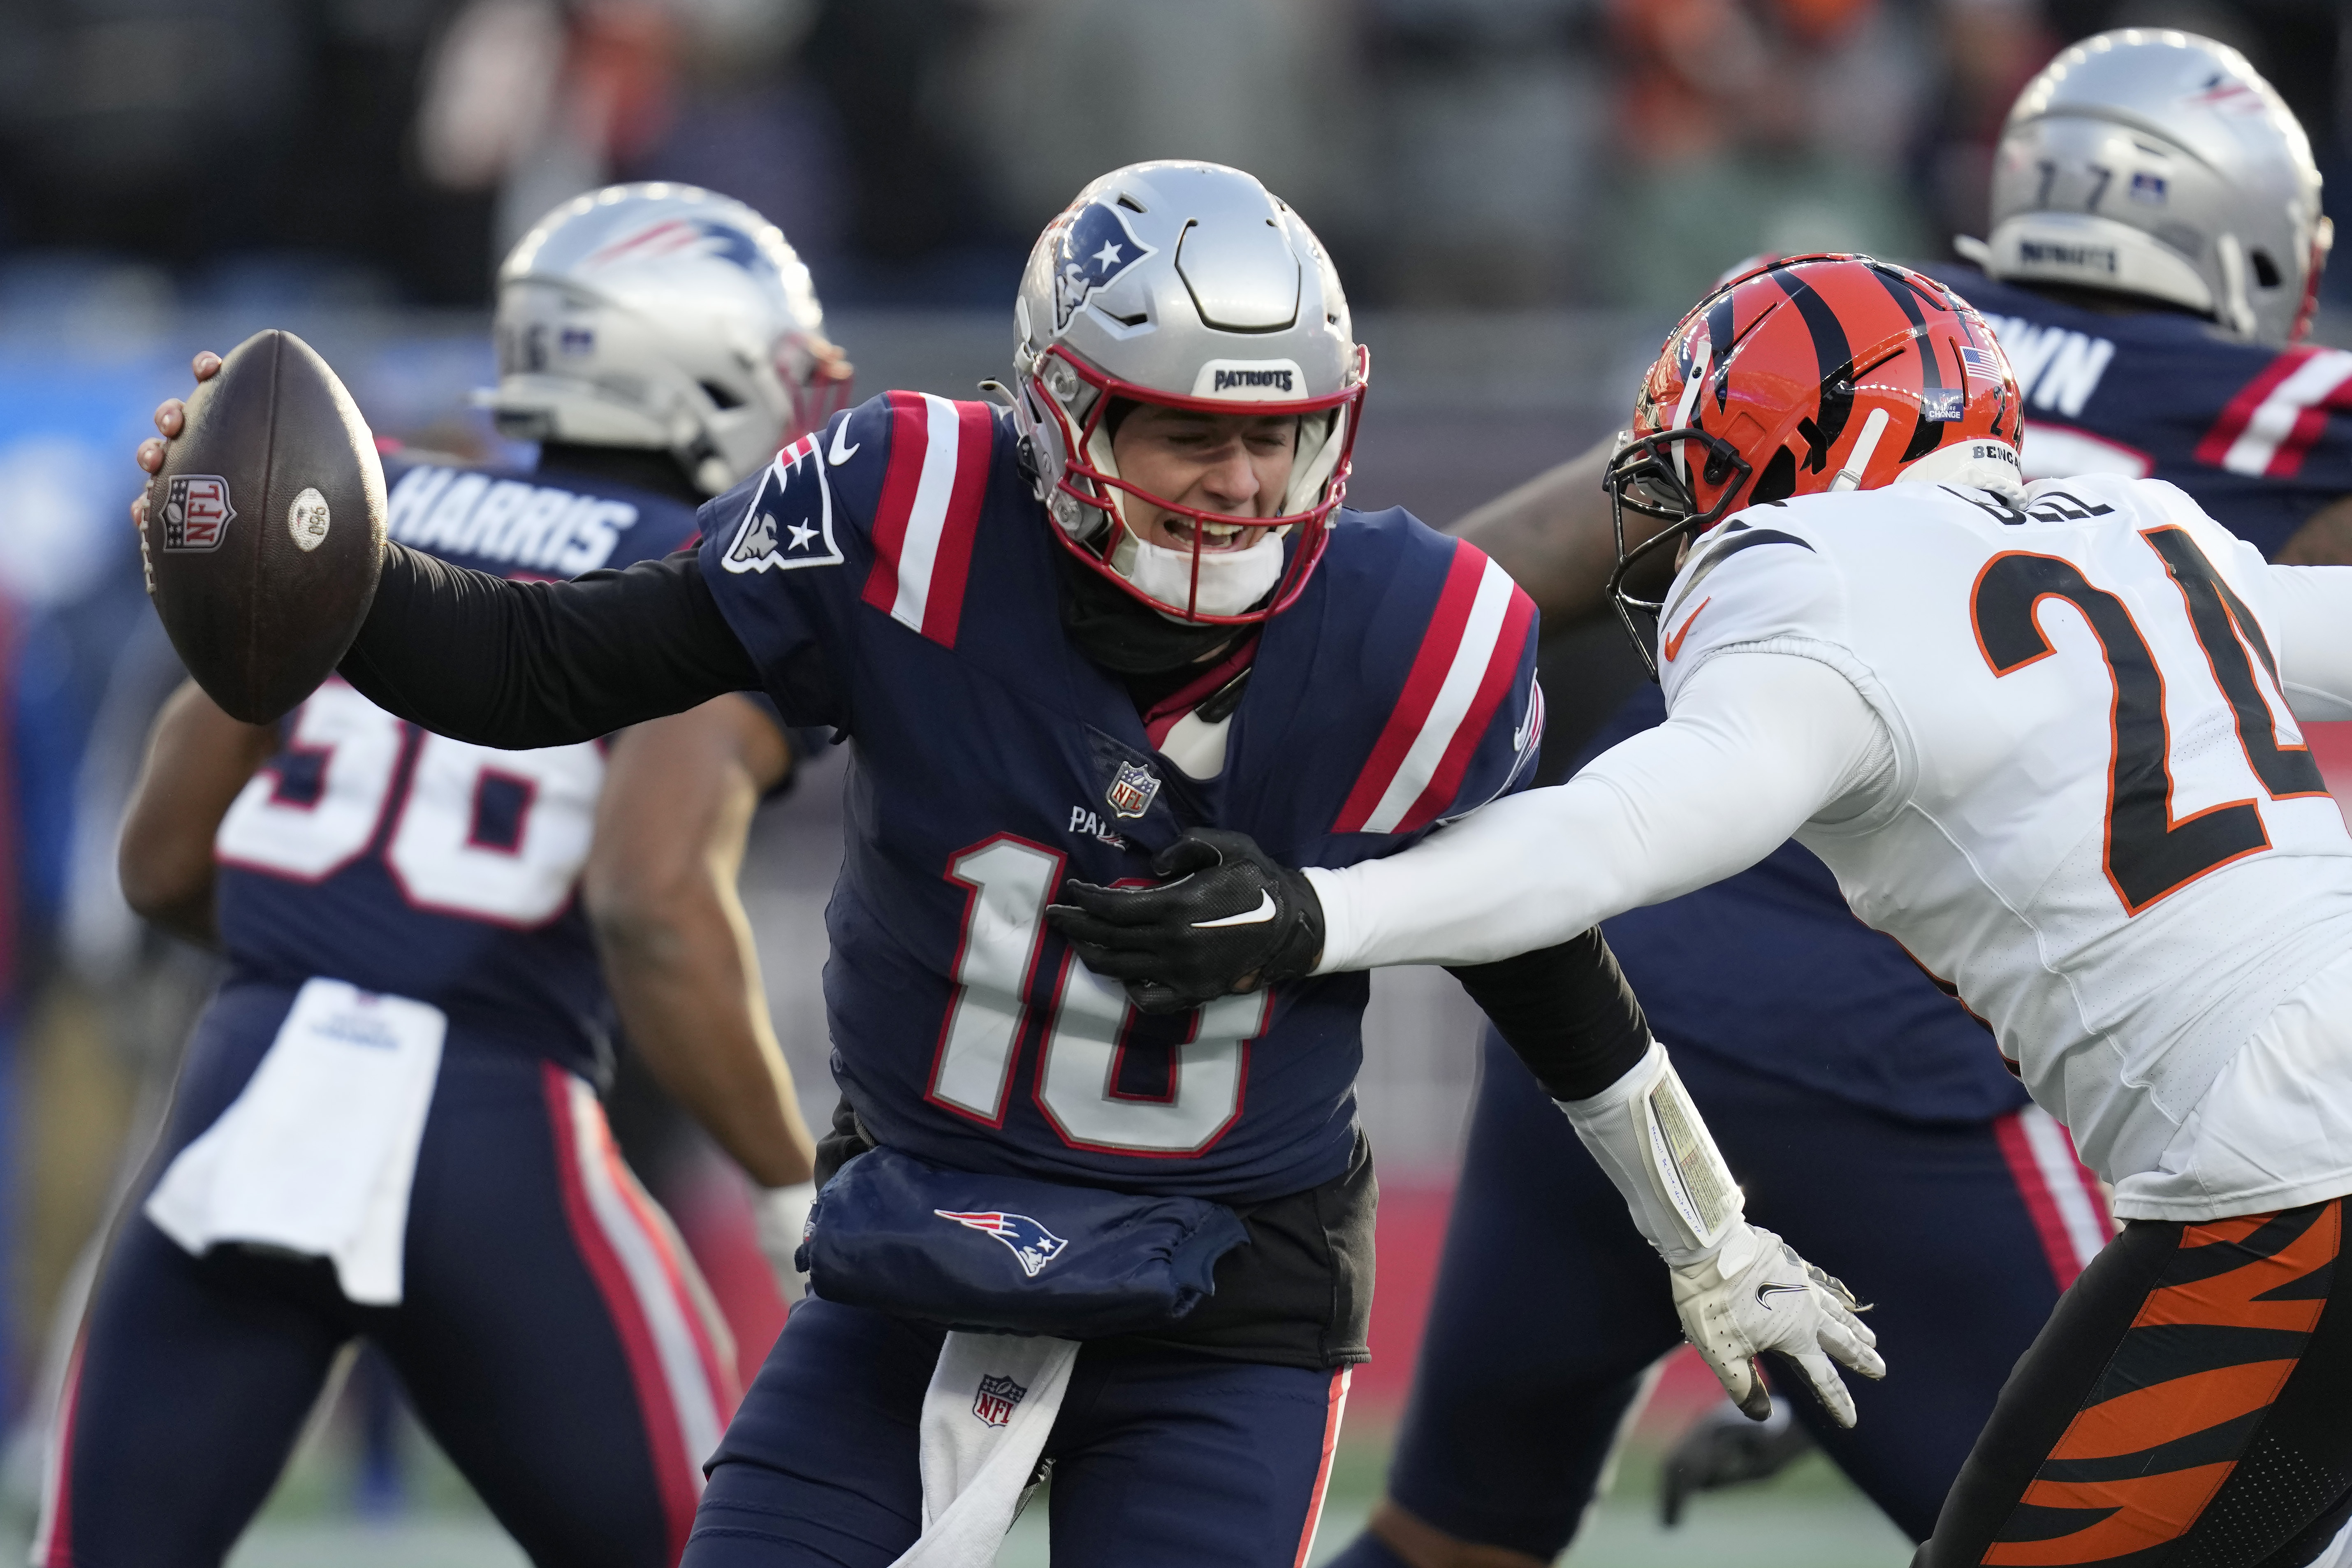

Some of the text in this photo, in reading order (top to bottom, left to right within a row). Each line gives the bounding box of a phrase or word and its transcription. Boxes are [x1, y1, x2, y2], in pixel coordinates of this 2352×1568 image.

[1214, 370, 1293, 392] PATRIOTS
[186, 484, 222, 542] NFL
[387, 464, 640, 575] HARRIS
[1969, 523, 2335, 919] 24
[1112, 783, 1143, 811] NFL
[924, 831, 1277, 1159] 10
